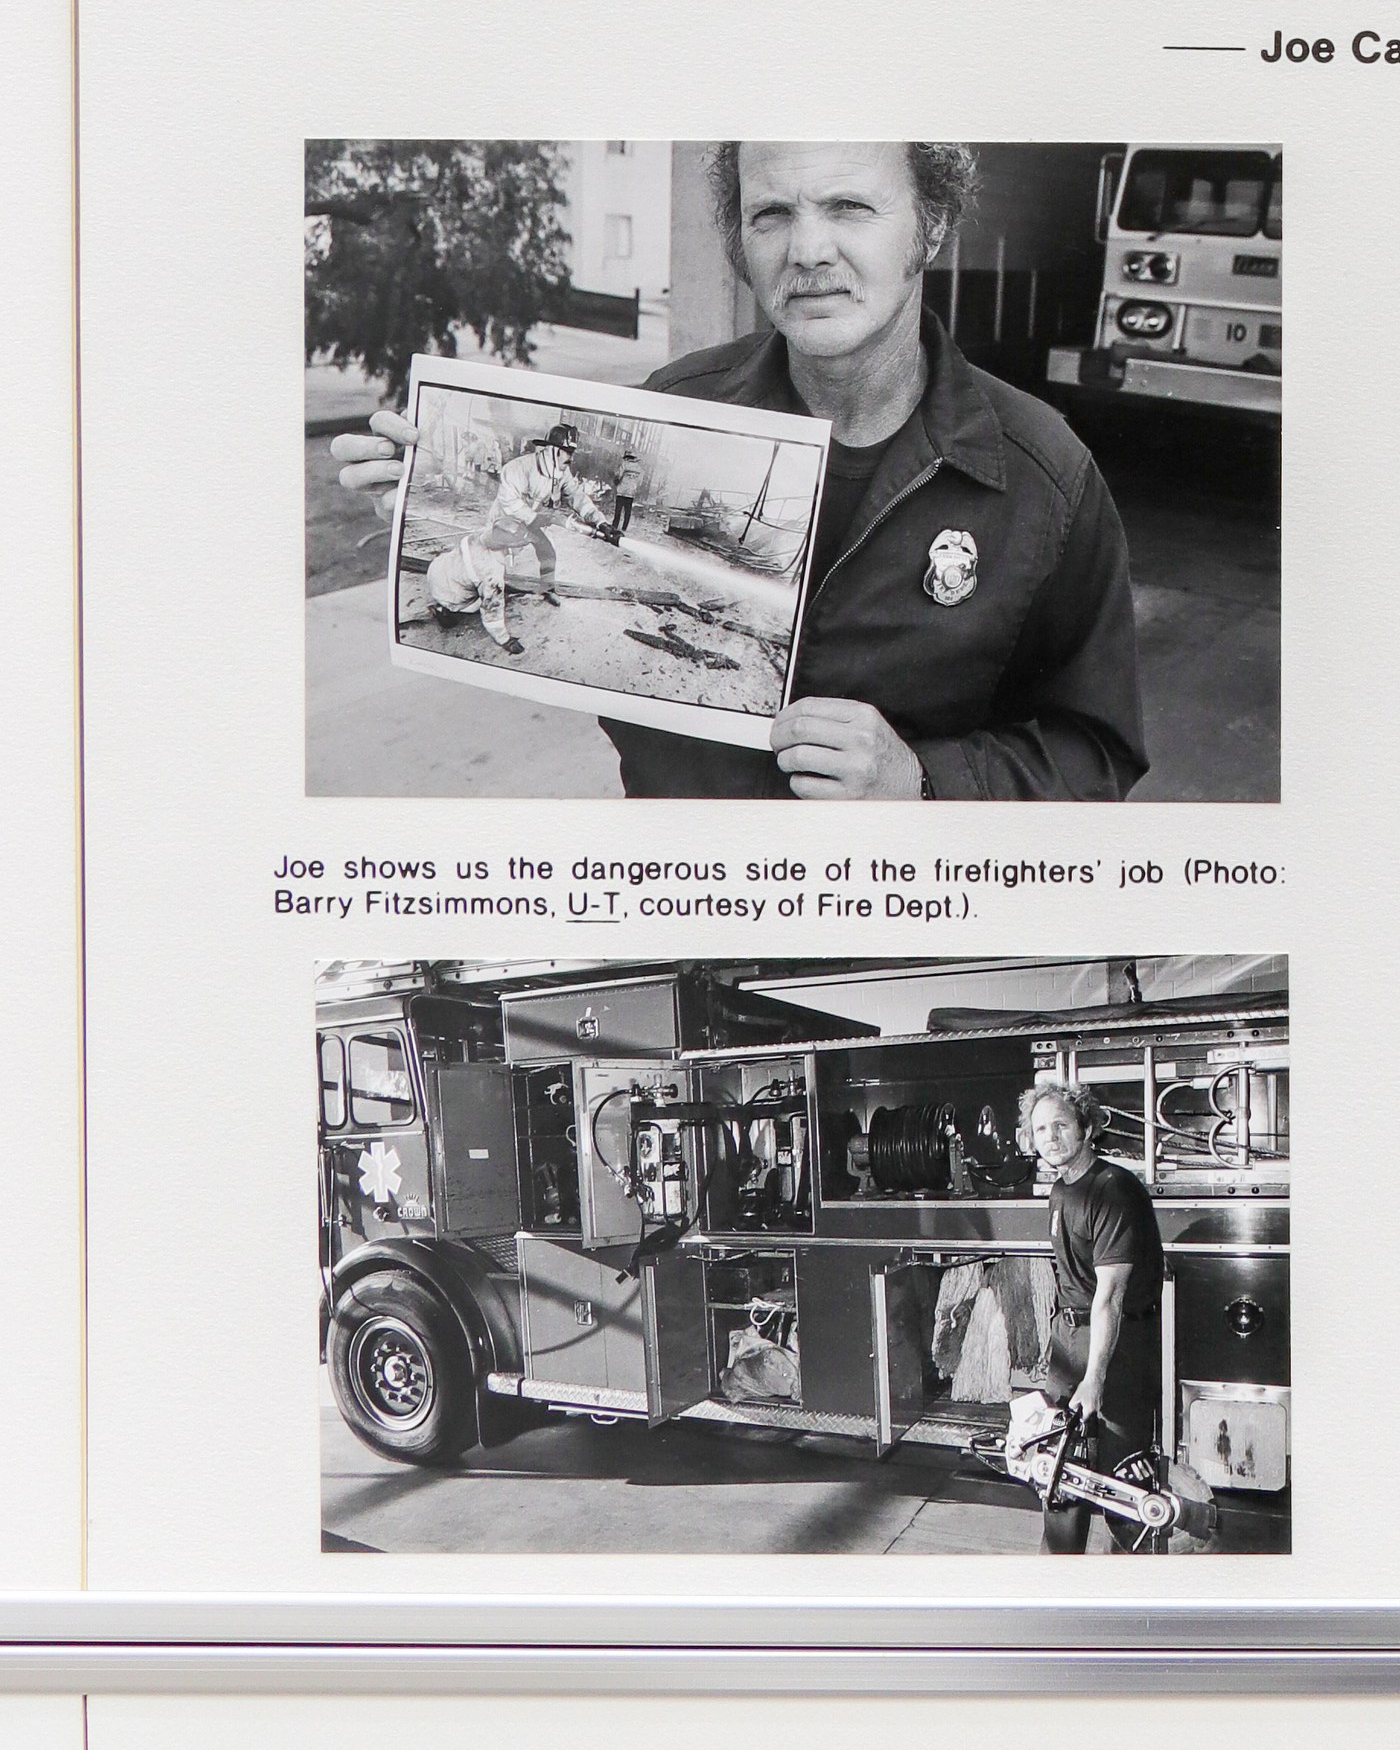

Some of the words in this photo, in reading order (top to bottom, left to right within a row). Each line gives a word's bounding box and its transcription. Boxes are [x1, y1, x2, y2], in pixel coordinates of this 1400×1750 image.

[1261, 30, 1334, 63] Joe
[1226, 323, 1247, 342] 10
[274, 856, 325, 880] Joe
[344, 856, 437, 880] shows
[456, 861, 489, 880] us
[508, 857, 553, 880] the
[571, 857, 727, 883] dangerous
[746, 858, 807, 881] side
[824, 858, 851, 882] of
[870, 858, 916, 882] the
[1119, 860, 1164, 889] job
[1184, 858, 1286, 886] (Photo:
[274, 890, 353, 919] Barry
[366, 890, 555, 918] Fitzsimmons,
[566, 891, 628, 919] U-T,
[639, 894, 766, 922] courtesy
[777, 892, 804, 917] of
[818, 893, 873, 918] Fire
[885, 892, 978, 923] Dept.).
